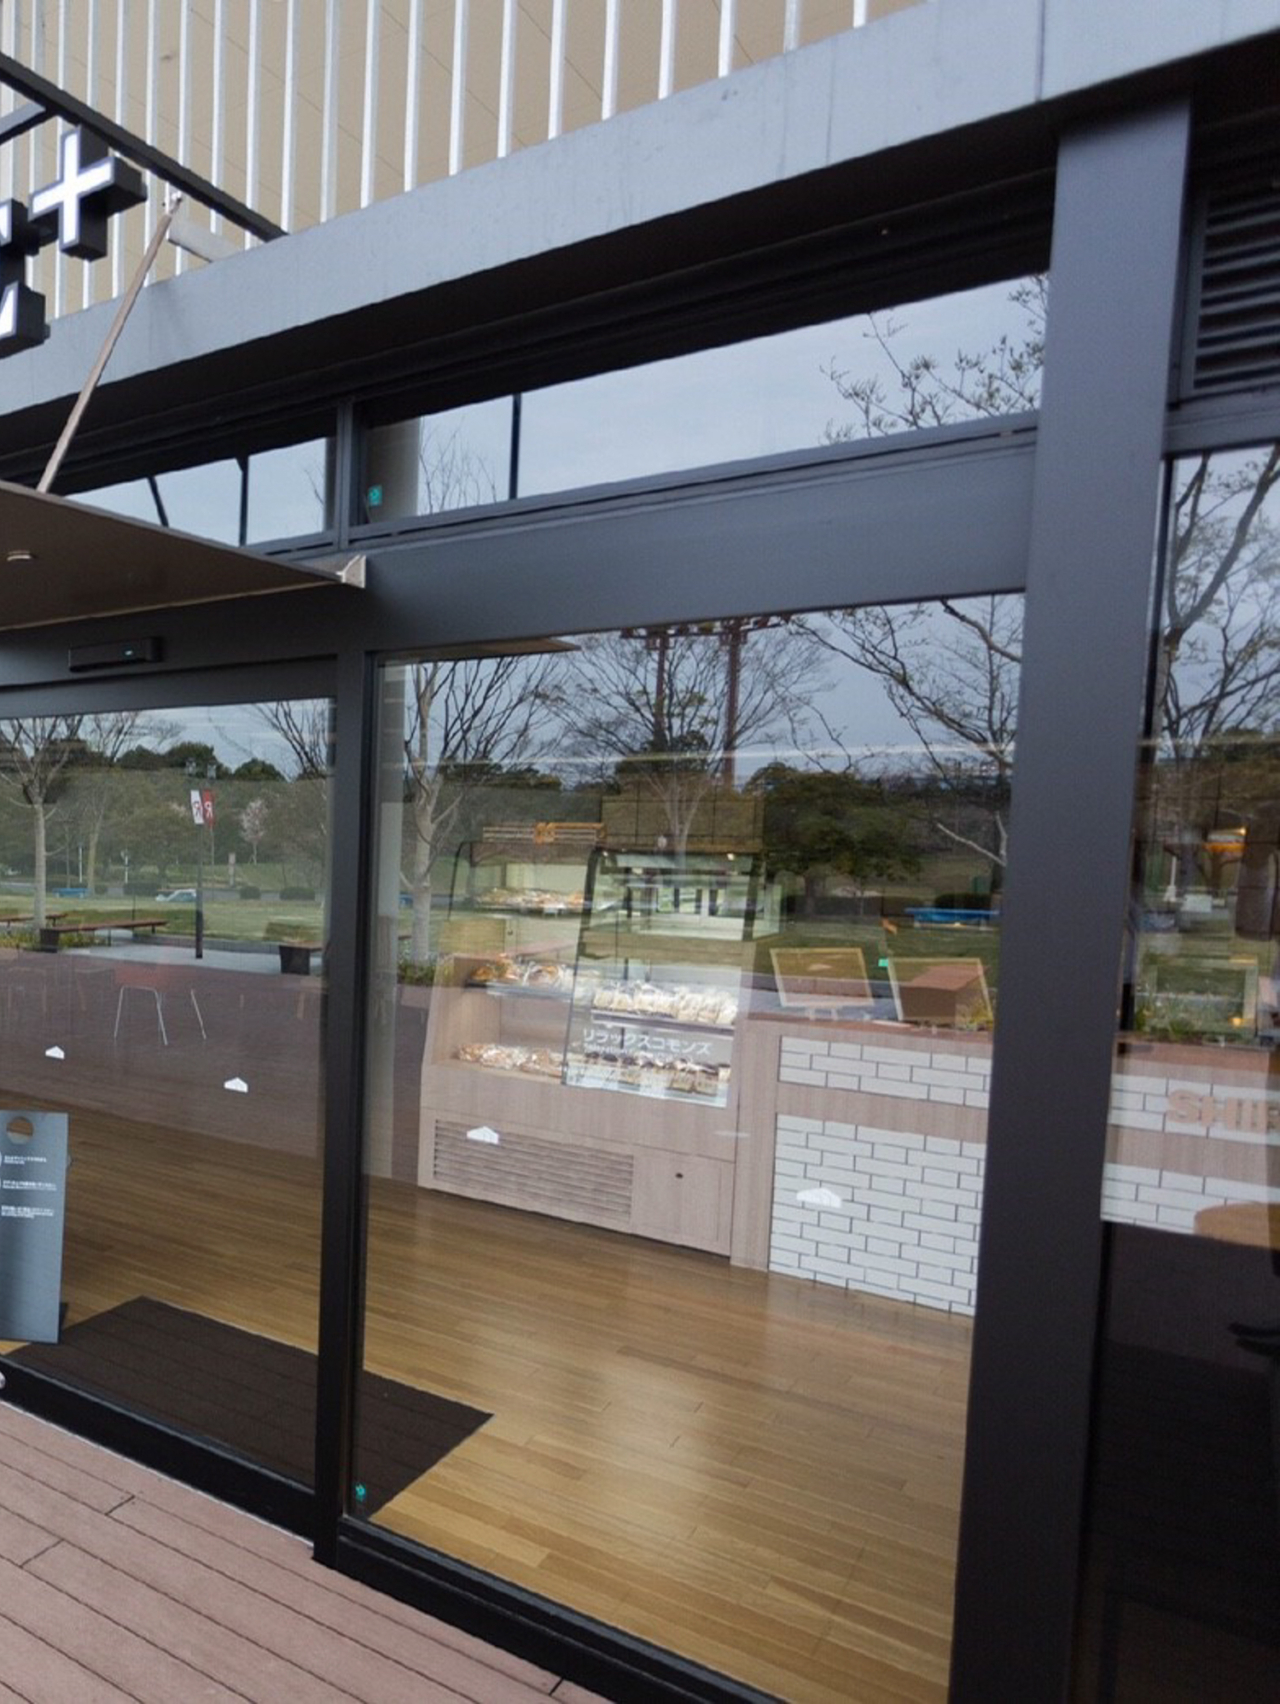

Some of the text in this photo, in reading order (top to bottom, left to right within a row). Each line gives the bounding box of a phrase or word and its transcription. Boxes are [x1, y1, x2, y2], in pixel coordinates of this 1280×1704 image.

[583, 1028, 713, 1055] リラックスコモンズ
